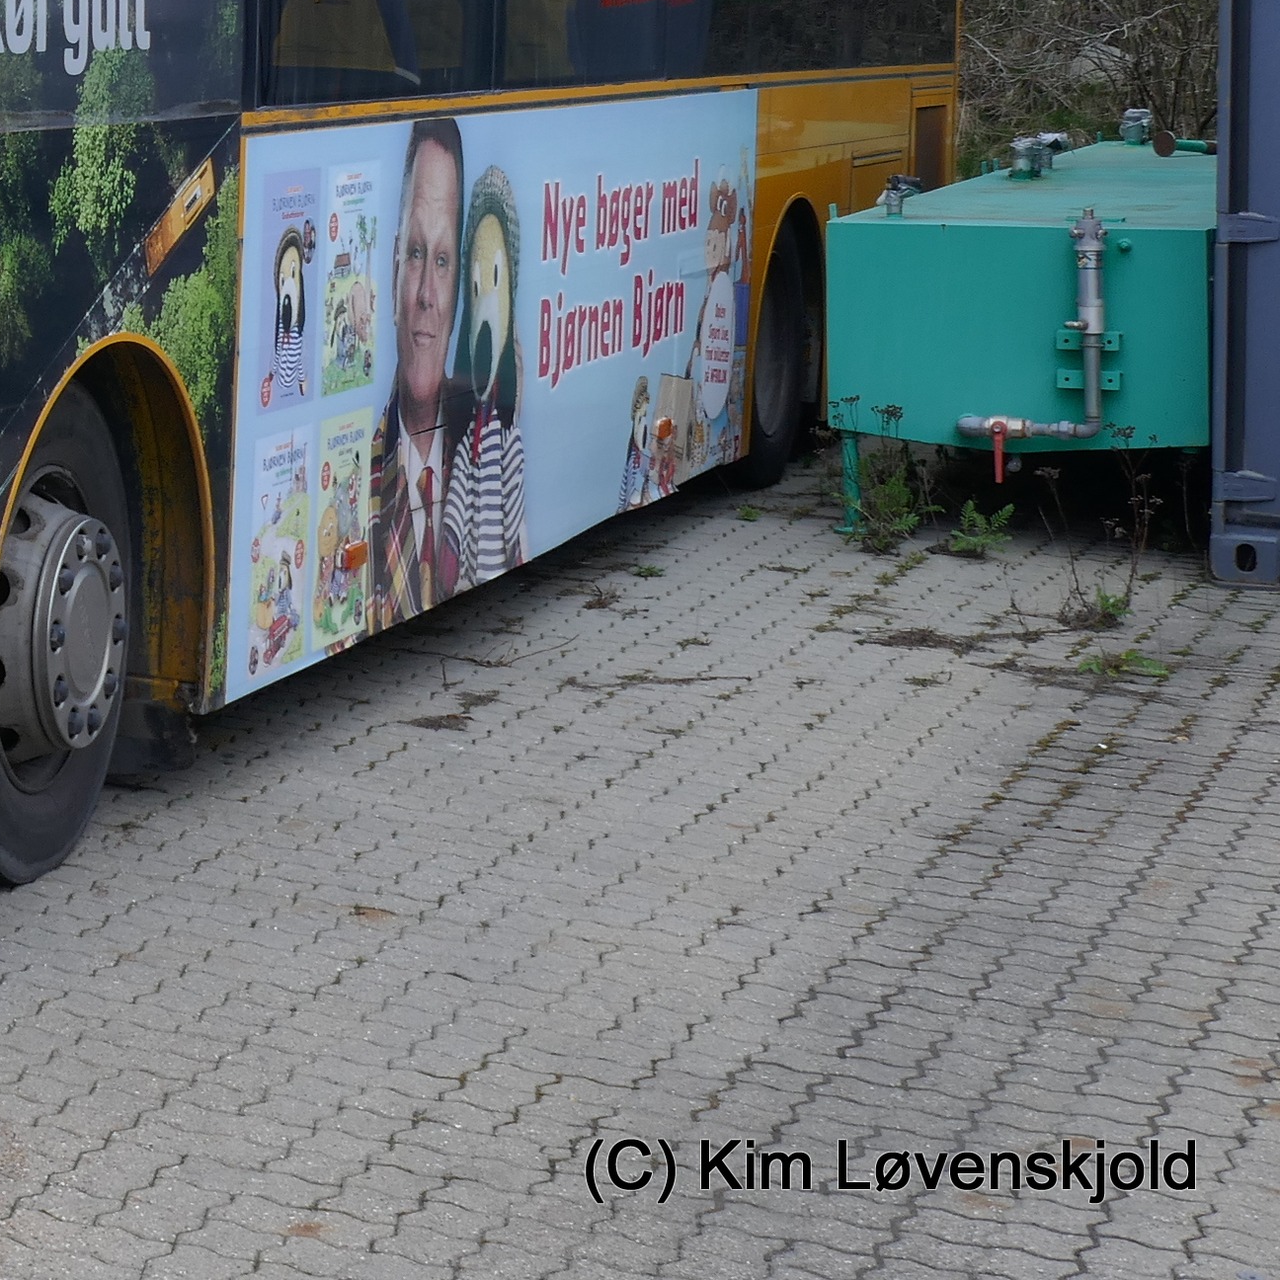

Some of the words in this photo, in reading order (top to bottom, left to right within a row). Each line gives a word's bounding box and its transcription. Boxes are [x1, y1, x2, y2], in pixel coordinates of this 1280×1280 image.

[541, 181, 586, 276] Nye
[595, 174, 654, 267] bøger
[659, 157, 700, 235] med
[537, 292, 624, 389] Bjørnen
[631, 268, 685, 359] Bjørn
